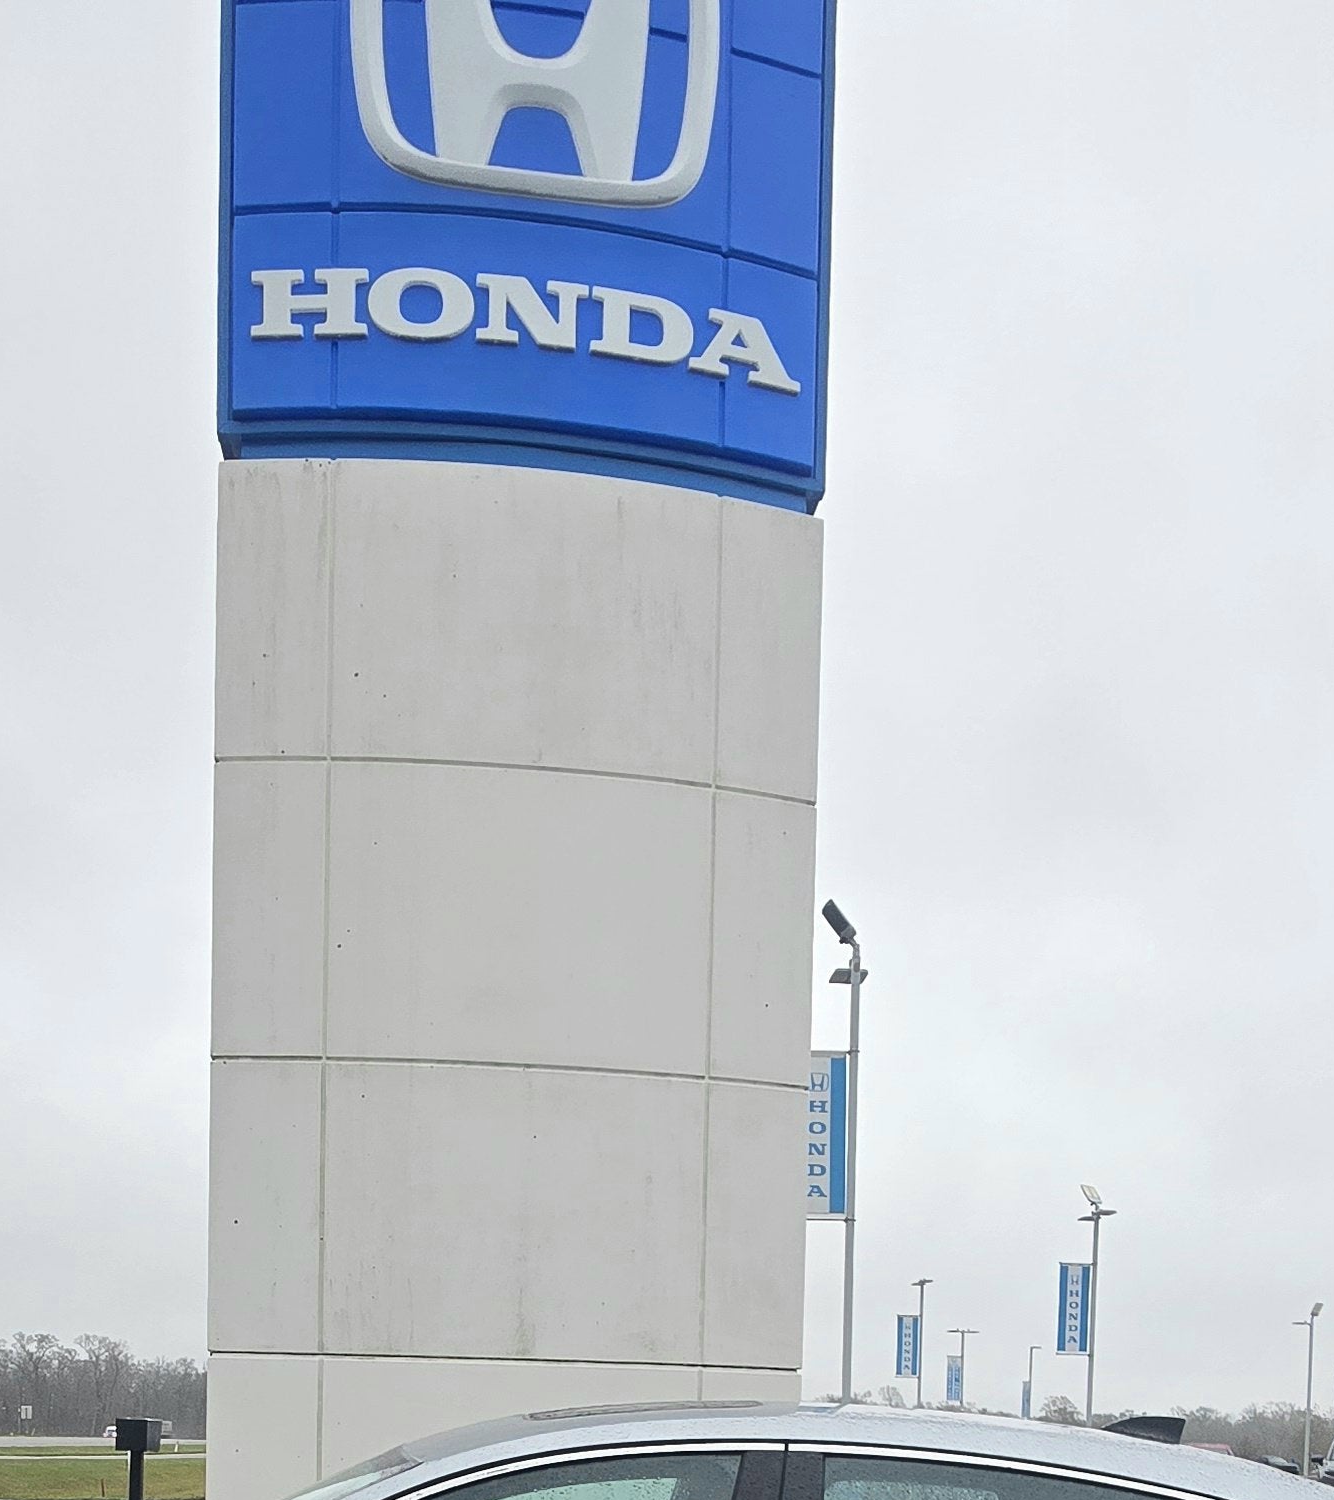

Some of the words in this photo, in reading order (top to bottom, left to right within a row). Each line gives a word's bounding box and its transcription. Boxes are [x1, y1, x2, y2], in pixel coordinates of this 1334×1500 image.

[249, 266, 802, 397] HONDA
[806, 1100, 829, 1198] HONDA
[1067, 1289, 1080, 1343] HONDA
